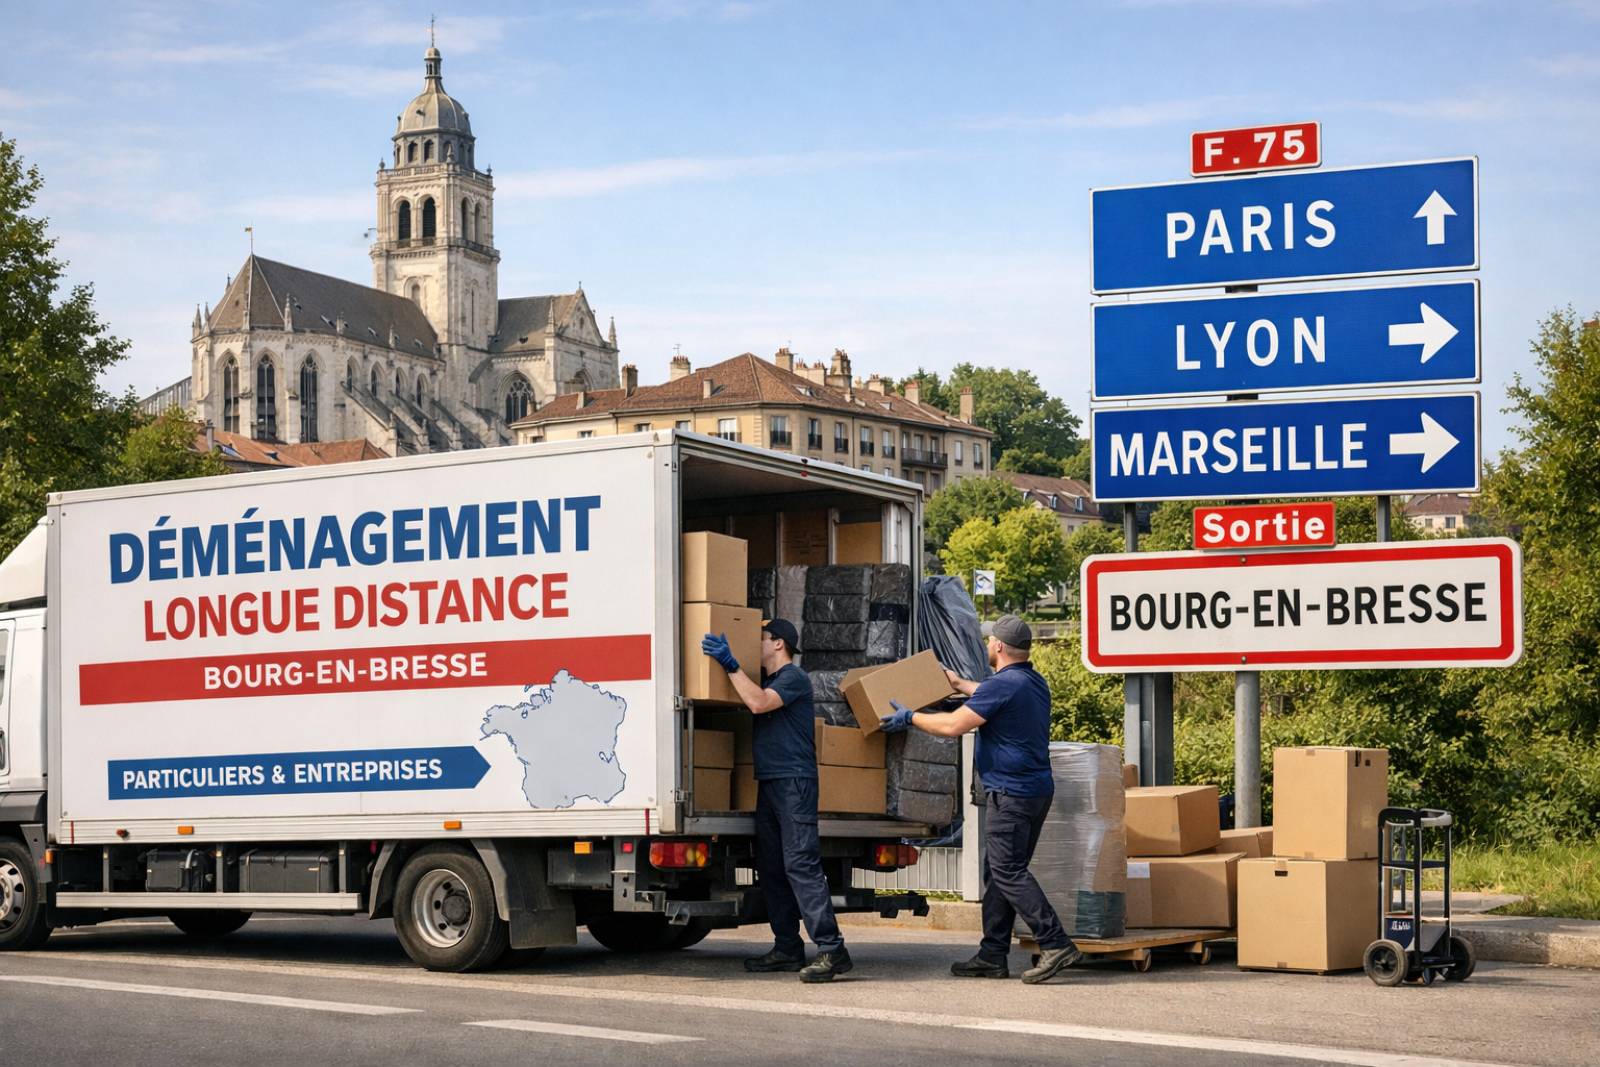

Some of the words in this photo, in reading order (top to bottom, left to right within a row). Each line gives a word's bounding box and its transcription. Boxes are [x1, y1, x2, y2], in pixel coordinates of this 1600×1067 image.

[1166, 200, 1337, 258] PARIS
[1176, 315, 1326, 370] LYON
[1110, 422, 1367, 477] MARSEILLE
[108, 495, 601, 584] DÉMÉNAGEMENT
[1202, 511, 1326, 544] Sortie
[143, 588, 320, 642] LONGUE
[333, 572, 569, 630] DISTANCE
[1110, 582, 1487, 631] BOURG-EN-BRESSE
[203, 652, 487, 691] BOURG-EN-BRESSE
[122, 765, 265, 790] PARTICULIERS
[271, 766, 286, 784] &
[294, 758, 443, 784] ENTREPRISES
